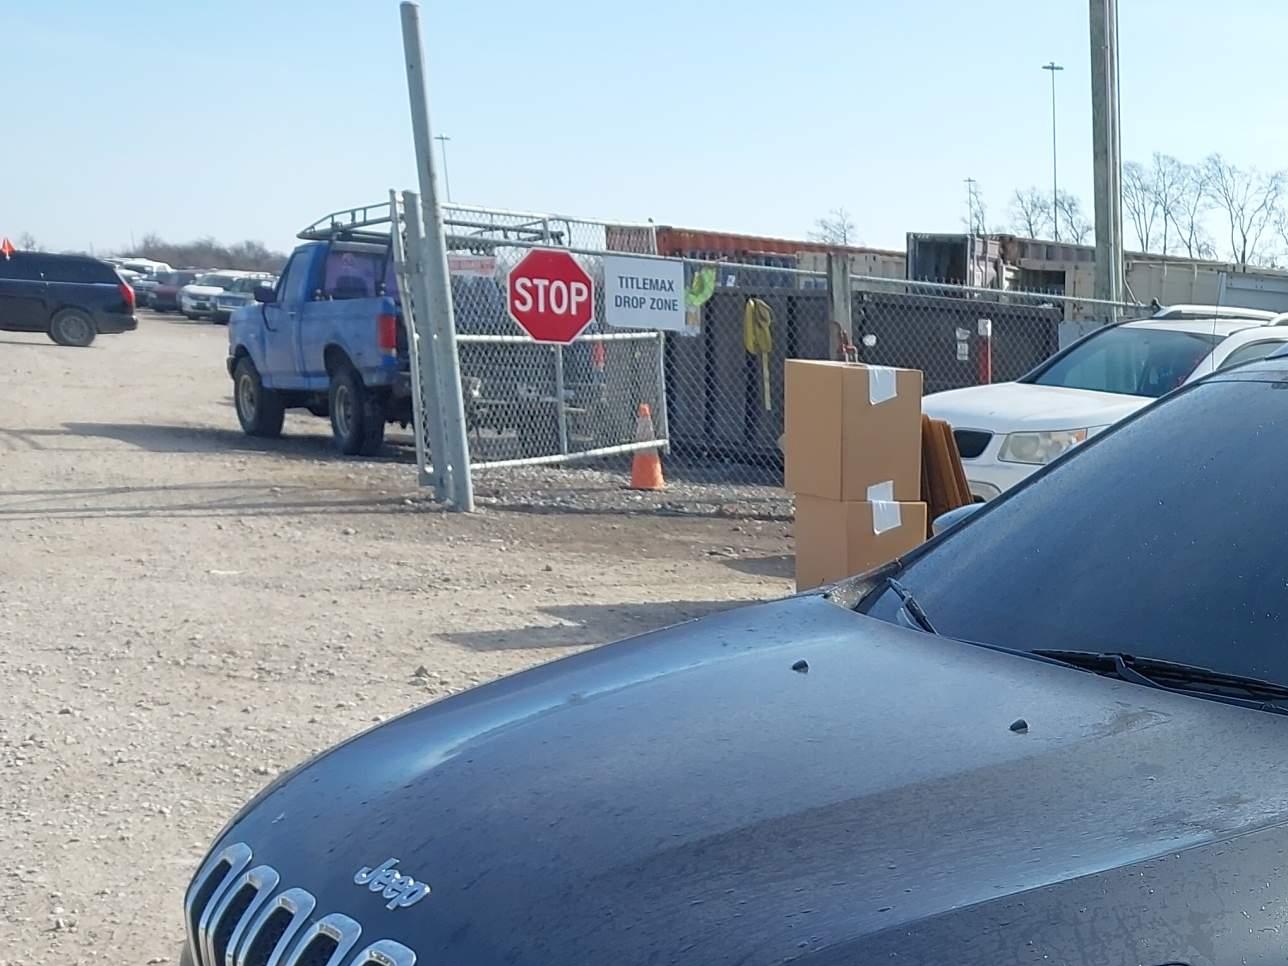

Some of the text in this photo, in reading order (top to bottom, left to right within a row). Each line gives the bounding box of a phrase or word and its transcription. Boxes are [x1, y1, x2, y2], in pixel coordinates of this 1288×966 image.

[514, 277, 588, 316] STOP
[618, 276, 674, 292] TITLEMAX
[614, 295, 679, 312] DROP ZONE
[354, 857, 430, 910] Jeep
